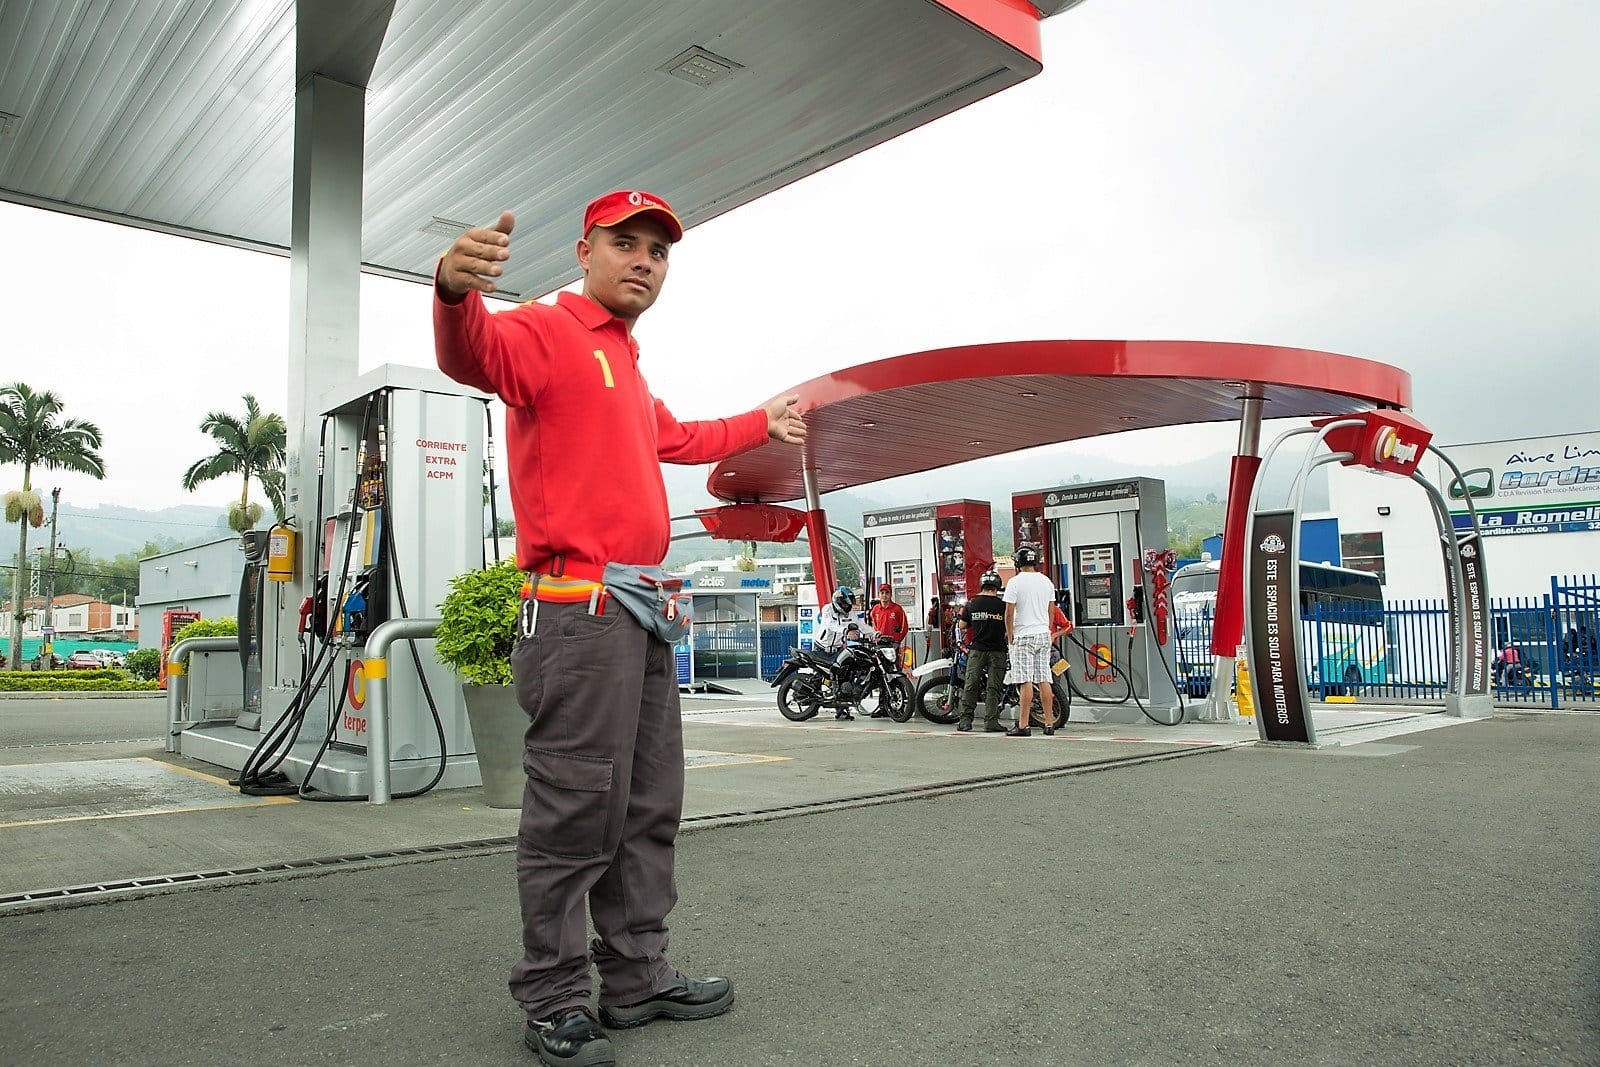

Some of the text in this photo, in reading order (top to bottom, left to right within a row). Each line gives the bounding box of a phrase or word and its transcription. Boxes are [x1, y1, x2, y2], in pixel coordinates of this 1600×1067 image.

[593, 349, 615, 388] 1
[415, 439, 468, 452] CORRIENTE
[425, 455, 457, 466] EXTRA
[1506, 451, 1555, 465] Aire
[427, 470, 454, 480] ACPM
[1477, 514, 1503, 527] La
[1266, 559, 1278, 581] ESTE
[740, 578, 770, 588] motos
[1266, 584, 1278, 622] ESPACIO
[1267, 623, 1279, 635] ES
[1466, 562, 1483, 691] ESTE ESPACIO ES SOLO PARA MOTEROS
[1268, 636, 1280, 659] SOLO
[1271, 660, 1282, 683] PARA
[1273, 685, 1289, 725] MOTEROS
[344, 711, 367, 736] terpe
